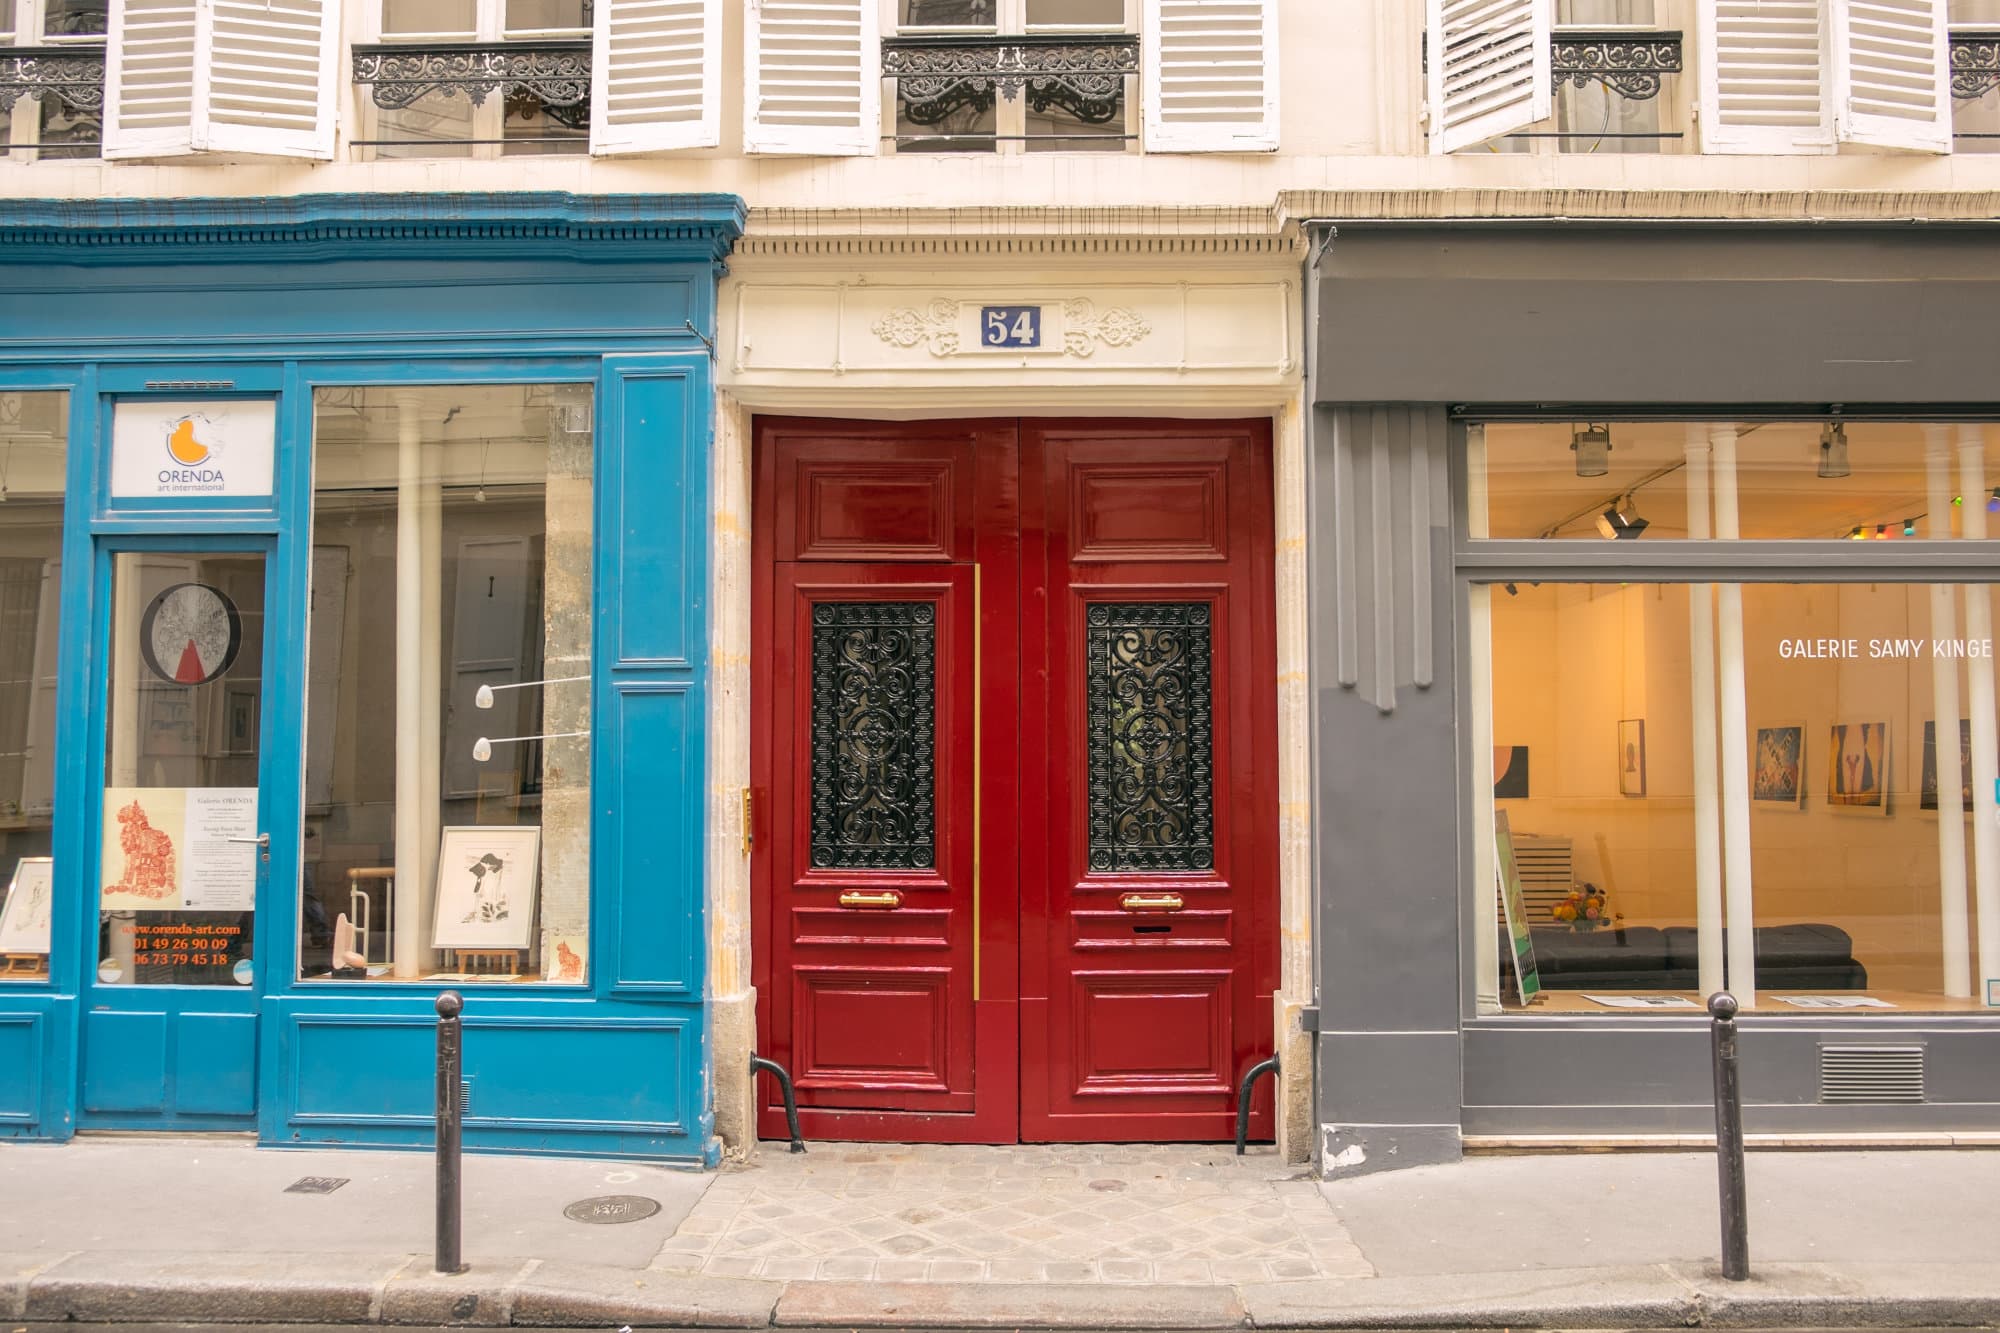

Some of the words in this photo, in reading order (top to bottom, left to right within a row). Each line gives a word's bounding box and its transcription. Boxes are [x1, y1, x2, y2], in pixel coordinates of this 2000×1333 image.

[988, 311, 1034, 344] 54
[158, 470, 224, 483] ORENDA
[157, 484, 170, 492] art
[172, 483, 225, 492] international
[1778, 639, 1859, 658] GALERIE
[1869, 639, 1924, 658] SAMY
[1932, 639, 1993, 658] KINGE
[121, 923, 241, 935] www.orenda-art.com
[133, 938, 148, 950] 01
[152, 938, 169, 950] 49
[172, 938, 189, 950] 26
[192, 938, 208, 950] 90
[211, 938, 228, 950] 09
[132, 953, 149, 965] 06
[152, 953, 168, 965] 73
[172, 953, 189, 965] 79
[191, 953, 208, 965] 45
[211, 953, 228, 965] 18
